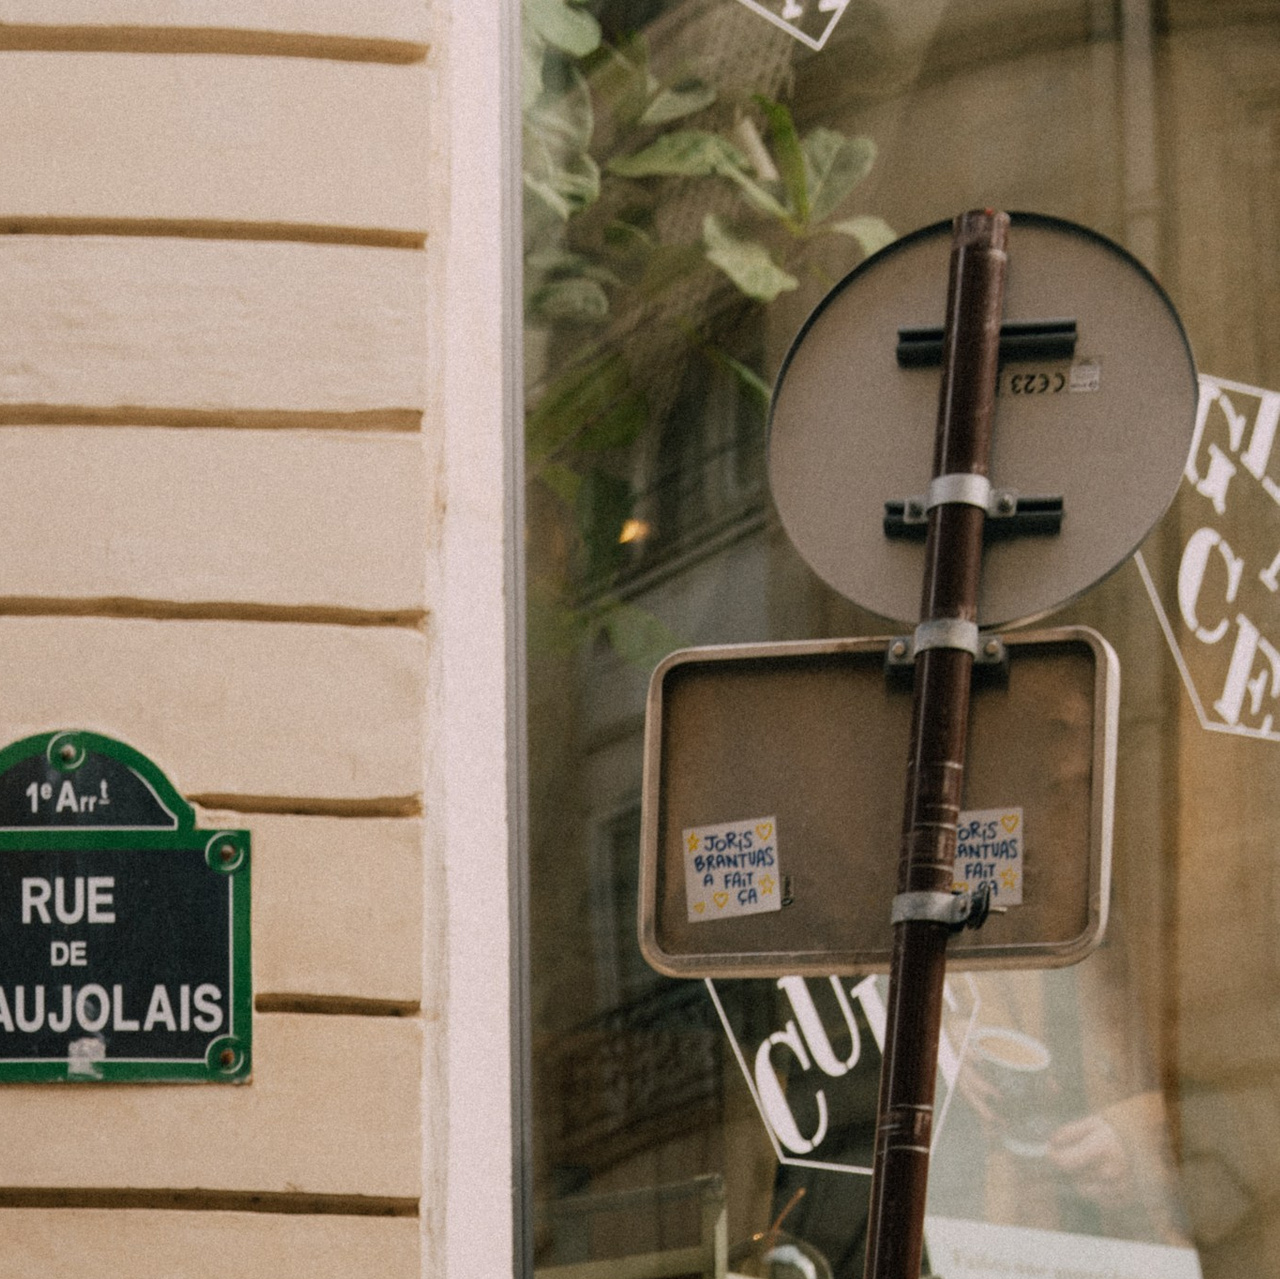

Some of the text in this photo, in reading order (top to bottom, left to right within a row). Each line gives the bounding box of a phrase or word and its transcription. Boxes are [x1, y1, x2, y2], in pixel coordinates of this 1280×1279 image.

[694, 846, 775, 873] BRANTUAS
[22, 876, 117, 925] RUE
[50, 941, 88, 967] DE
